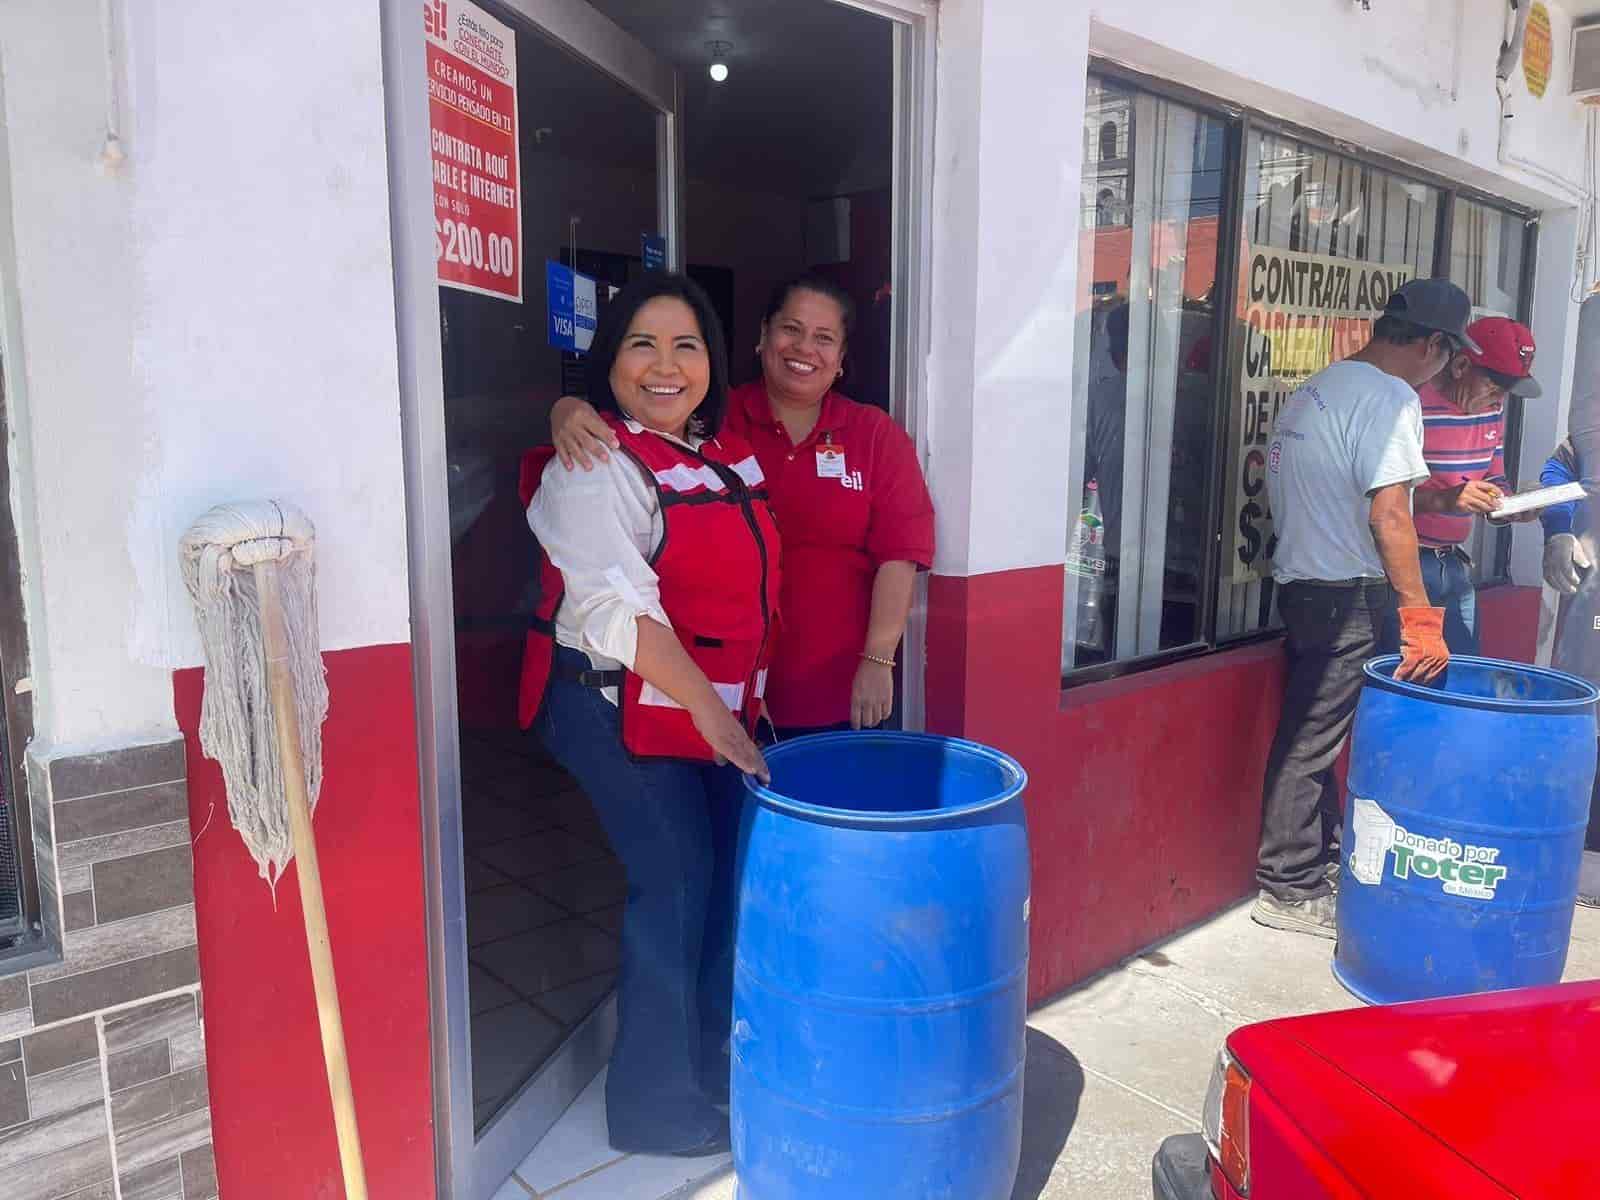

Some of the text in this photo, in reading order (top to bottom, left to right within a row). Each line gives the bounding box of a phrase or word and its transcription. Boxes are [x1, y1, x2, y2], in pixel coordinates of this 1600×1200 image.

[434, 59, 492, 103] CREAMOS UN
[457, 93, 491, 122] PENSADO
[491, 110, 502, 129] EN
[502, 114, 511, 131] TI
[432, 128, 508, 181] CONTRATA AQUÍ
[461, 169, 468, 194] E
[470, 173, 515, 209] INTERNET
[1250, 254, 1351, 311] CONTRATA
[553, 315, 573, 337] VISA
[841, 471, 863, 491] ei!
[1394, 828, 1498, 862] Donado por
[1393, 845, 1505, 887] Toter
